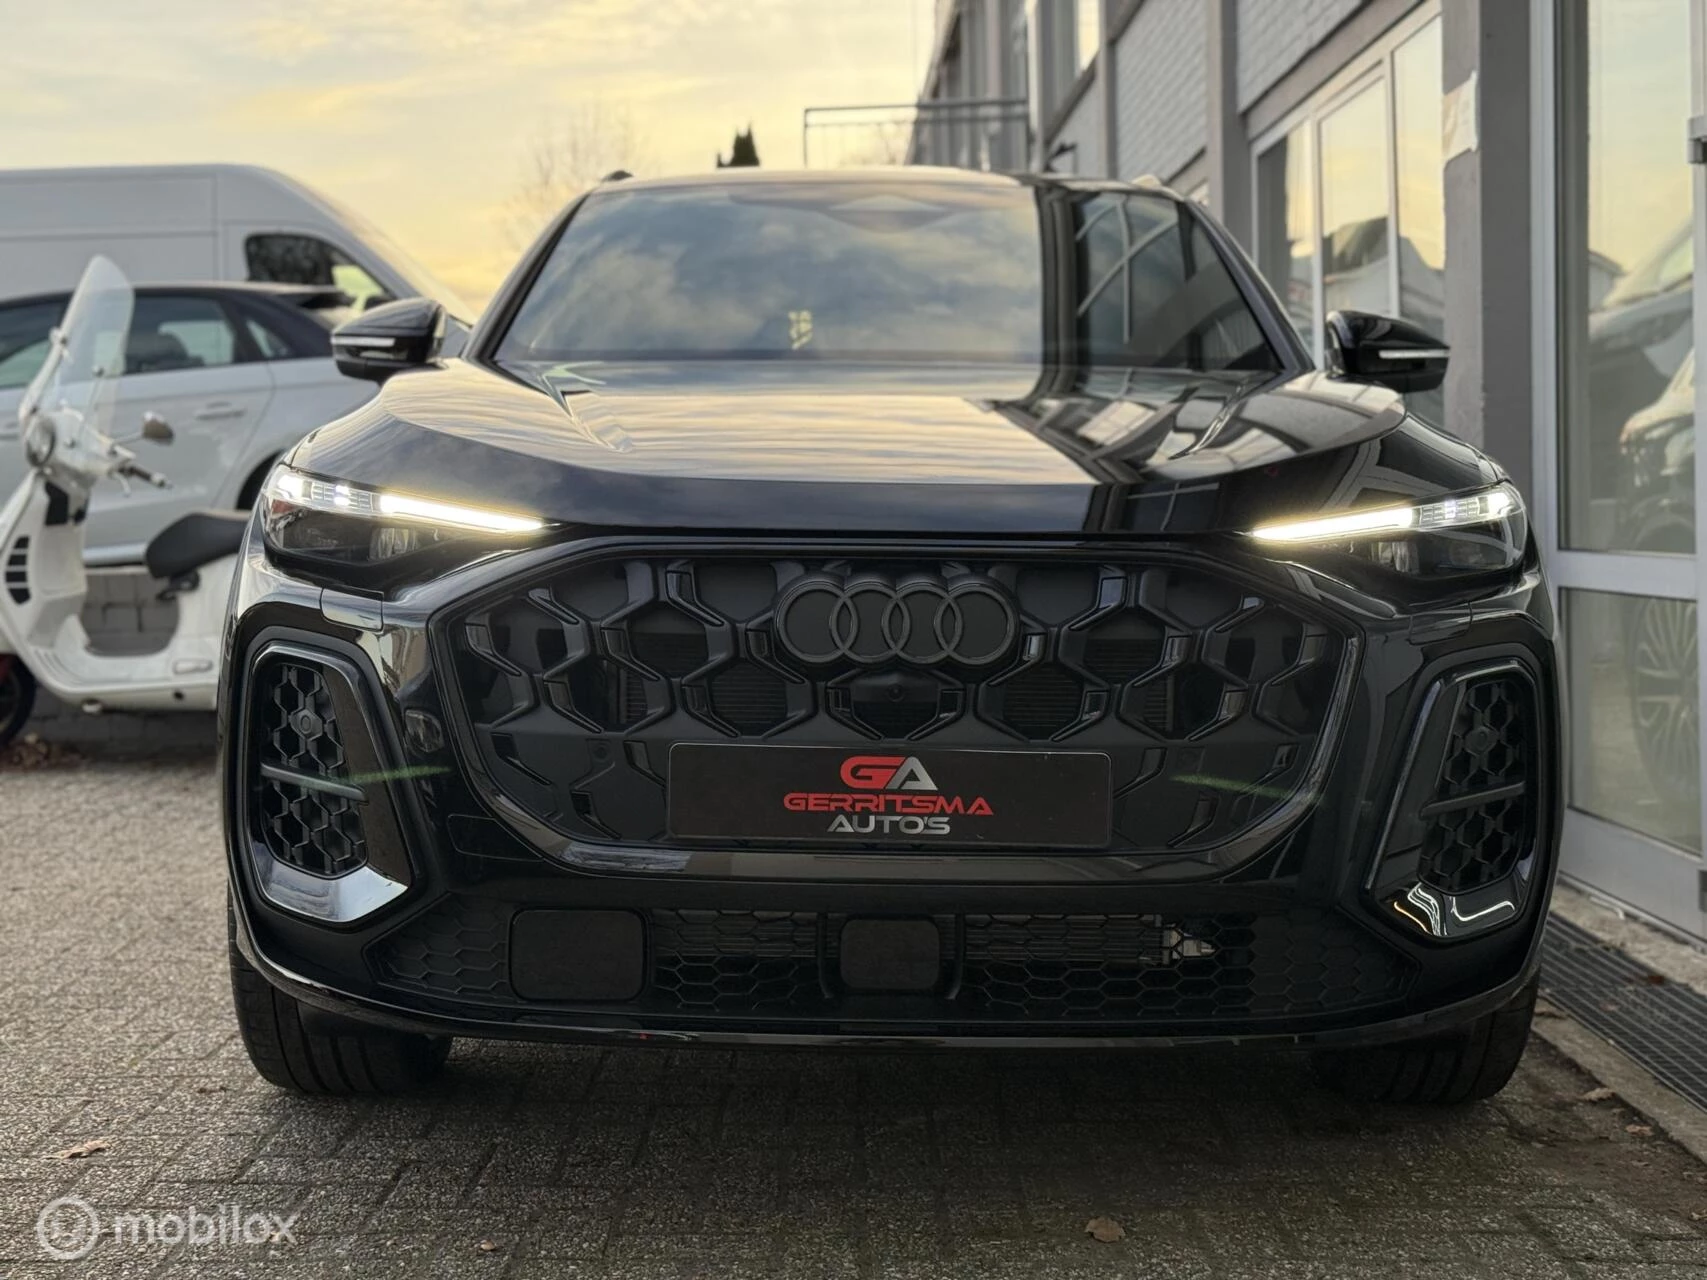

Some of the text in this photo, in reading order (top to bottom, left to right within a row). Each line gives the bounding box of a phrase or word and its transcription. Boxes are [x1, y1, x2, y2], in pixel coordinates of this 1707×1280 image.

[839, 755, 938, 791] GA
[783, 792, 994, 816] GERRITSMA
[826, 813, 951, 835] AUTO'S
